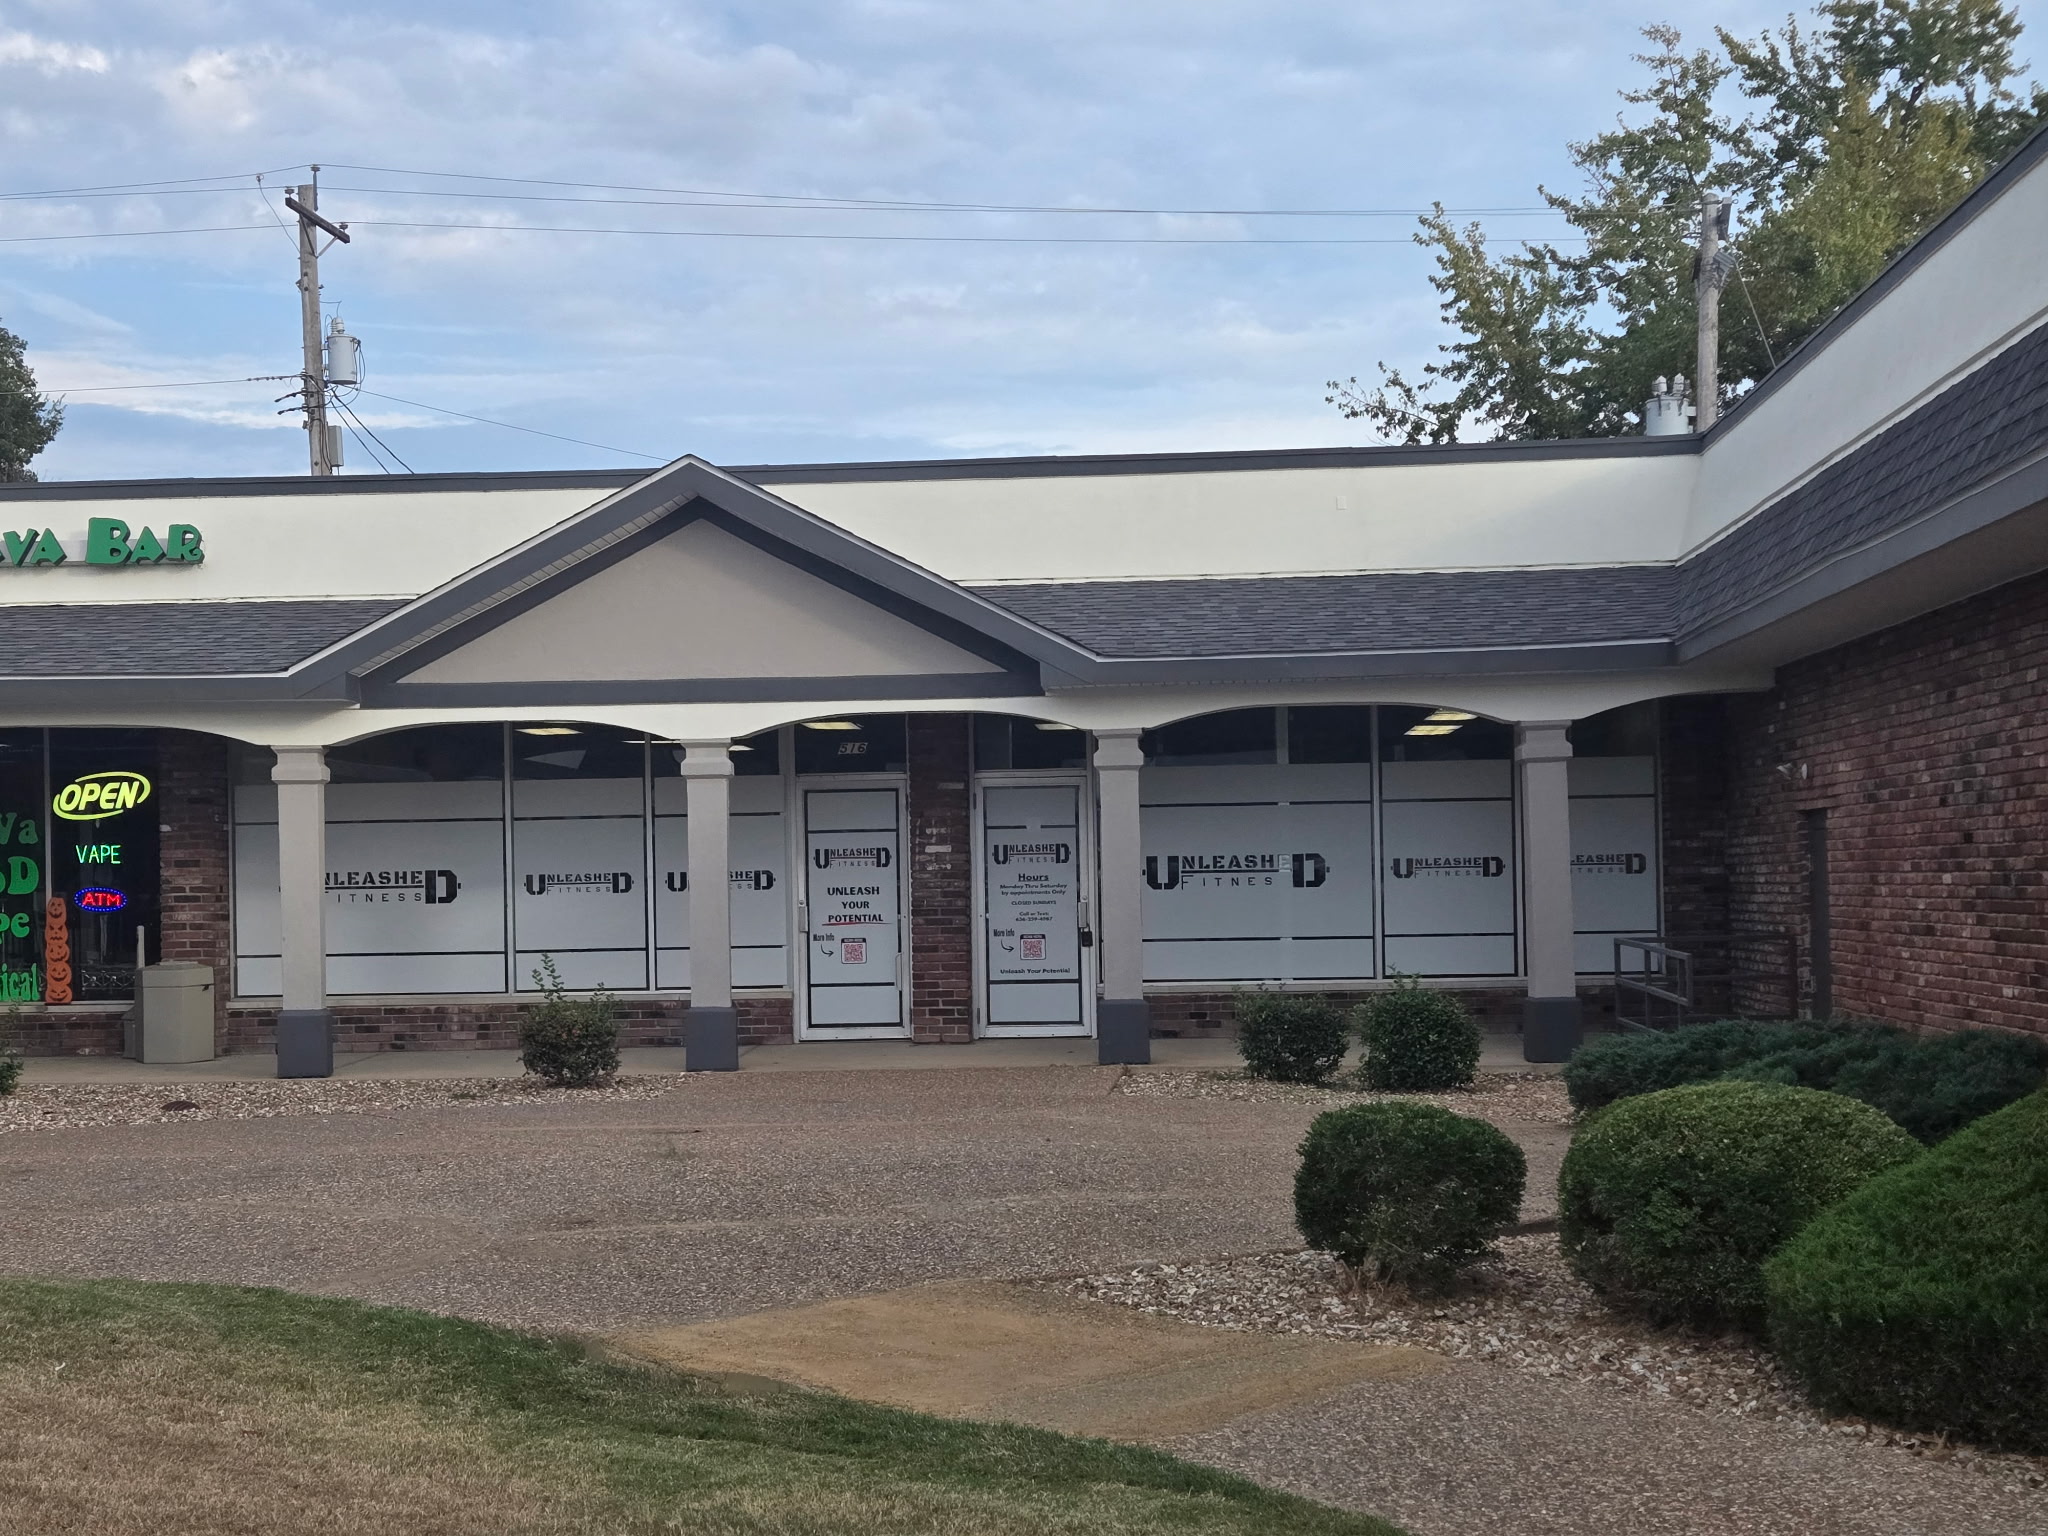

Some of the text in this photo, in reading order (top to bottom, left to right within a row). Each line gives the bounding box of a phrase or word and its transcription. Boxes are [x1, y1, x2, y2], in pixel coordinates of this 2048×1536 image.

[0, 517, 205, 567] VA BAR
[840, 743, 866, 753] 516
[60, 782, 140, 811] OPEN
[75, 845, 122, 864] VAPE
[815, 847, 891, 869] UNLEASHED
[993, 843, 1070, 865] UNLEASHED
[1571, 853, 1647, 874] EASHED
[1018, 873, 1050, 882] Hours
[1145, 853, 1327, 890] UNLEASHED
[1392, 856, 1504, 879] UNLEASHED
[325, 870, 458, 904] LEASHED
[525, 872, 633, 896] UNLEASHED
[827, 886, 880, 896] UNLEASH
[82, 893, 123, 906] ATM
[325, 892, 422, 903] ITNESS
[841, 901, 870, 910] YOUR
[828, 914, 884, 923] POTENTIAL
[813, 933, 825, 942] More
[993, 929, 1006, 937] More
[0, 963, 40, 1001] ical
